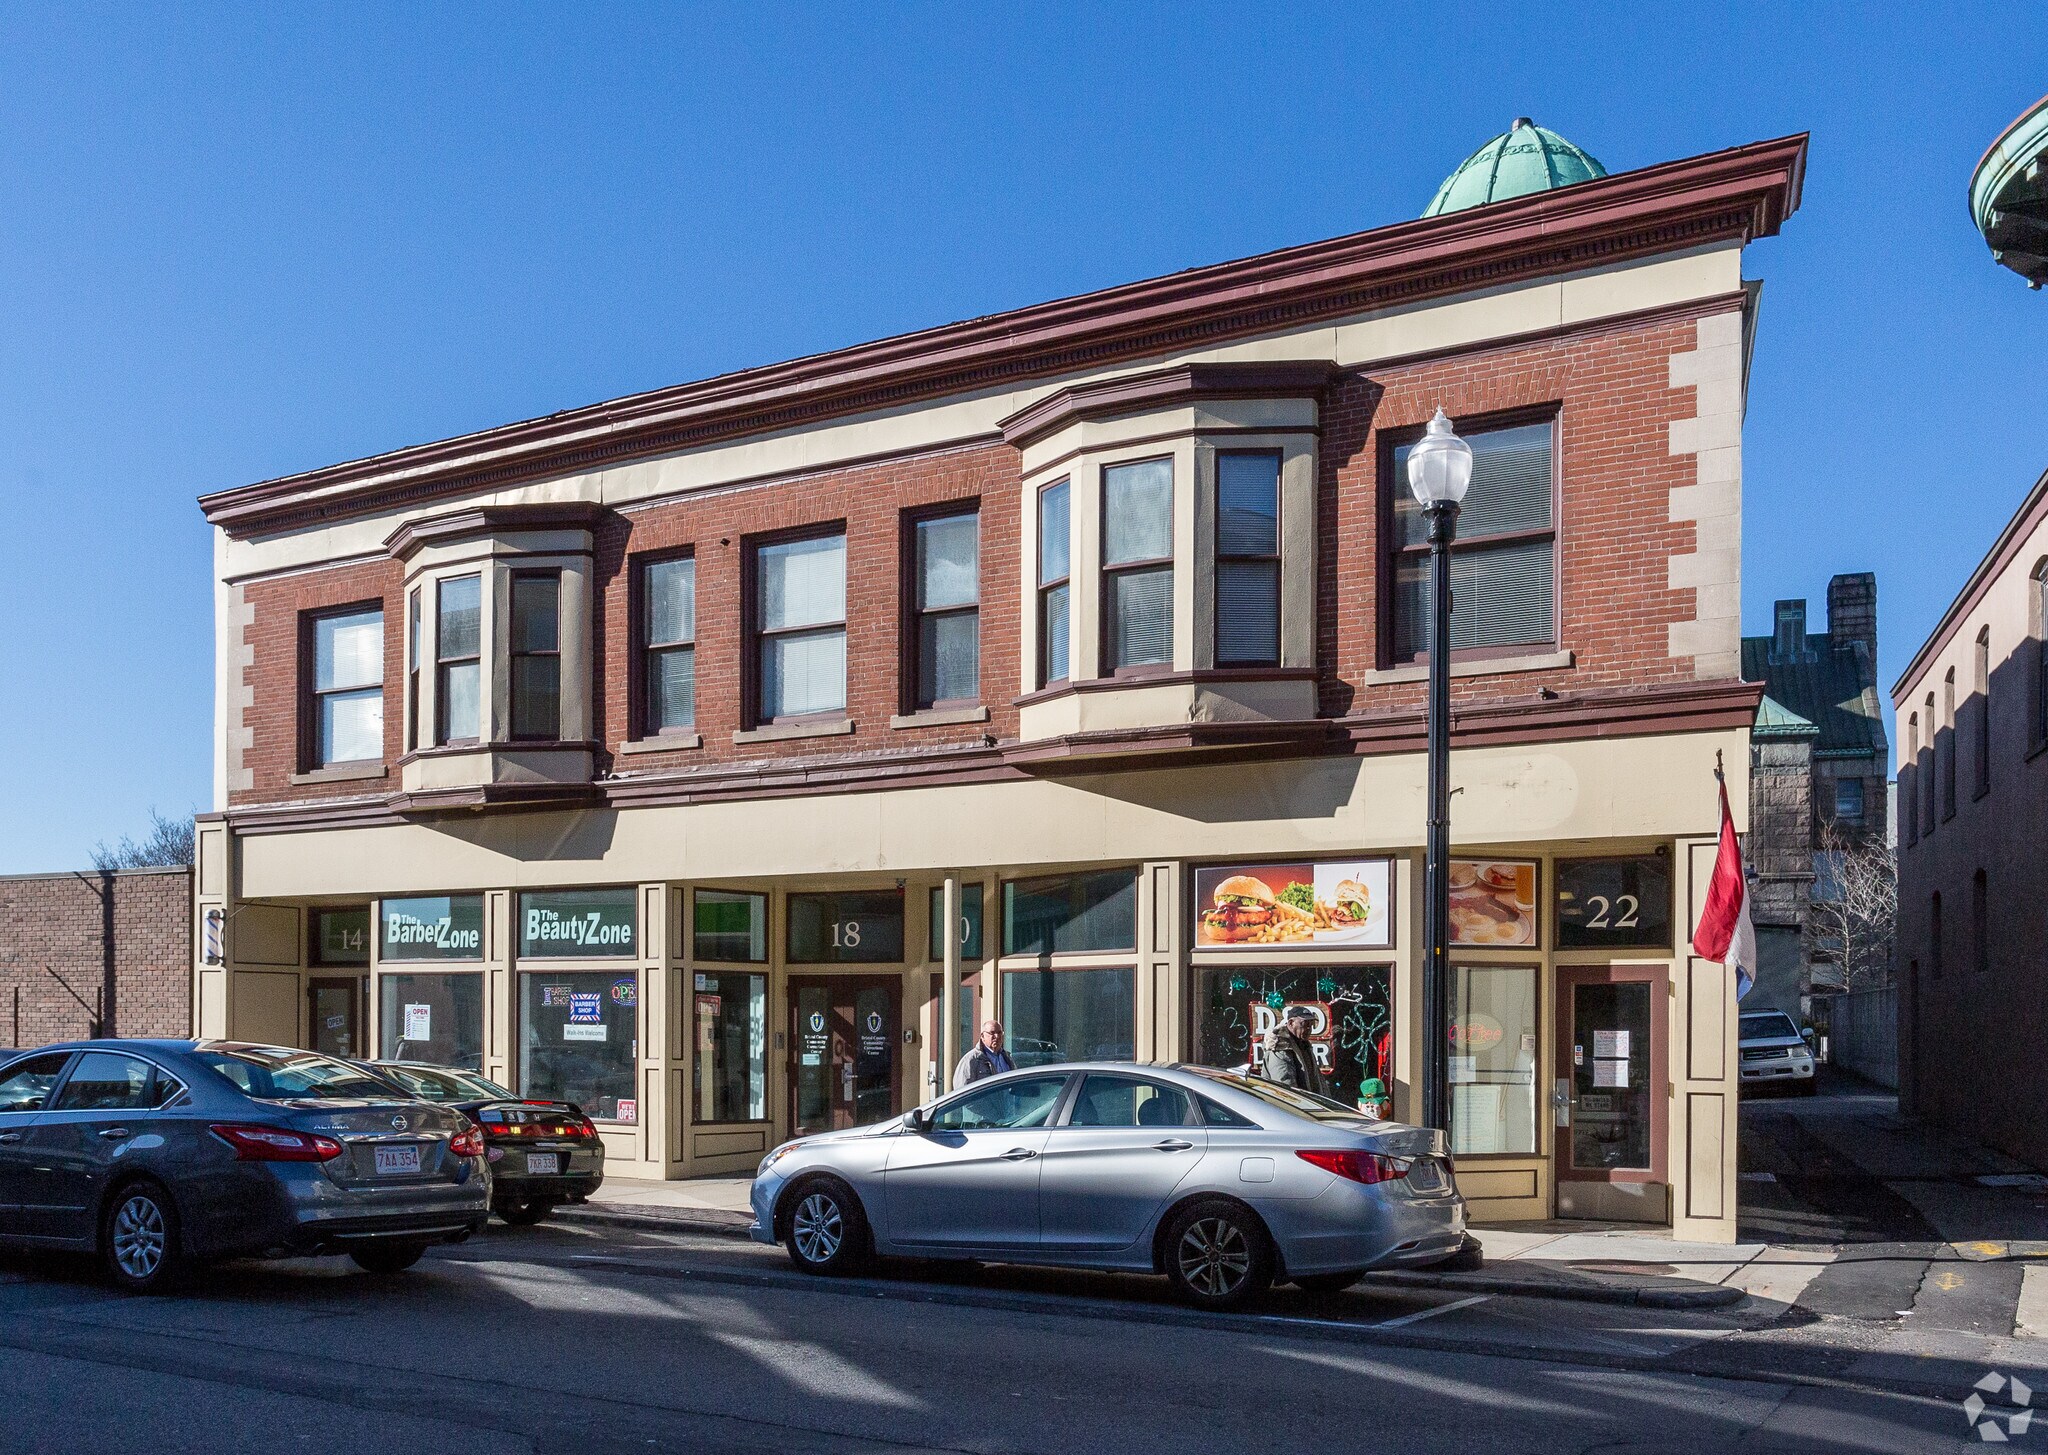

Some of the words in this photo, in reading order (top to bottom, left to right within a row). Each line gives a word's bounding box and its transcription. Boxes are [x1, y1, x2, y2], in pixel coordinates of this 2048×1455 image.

[401, 914, 417, 924] The
[541, 909, 558, 920] The
[1586, 895, 1639, 928] 22
[341, 928, 363, 951] 14
[832, 921, 861, 947] 18
[612, 985, 636, 999] OPE
[328, 1016, 344, 1027] OPEN
[1448, 1022, 1502, 1041] Coffee
[378, 1153, 397, 1168] 7AA
[400, 1150, 418, 1167] 354
